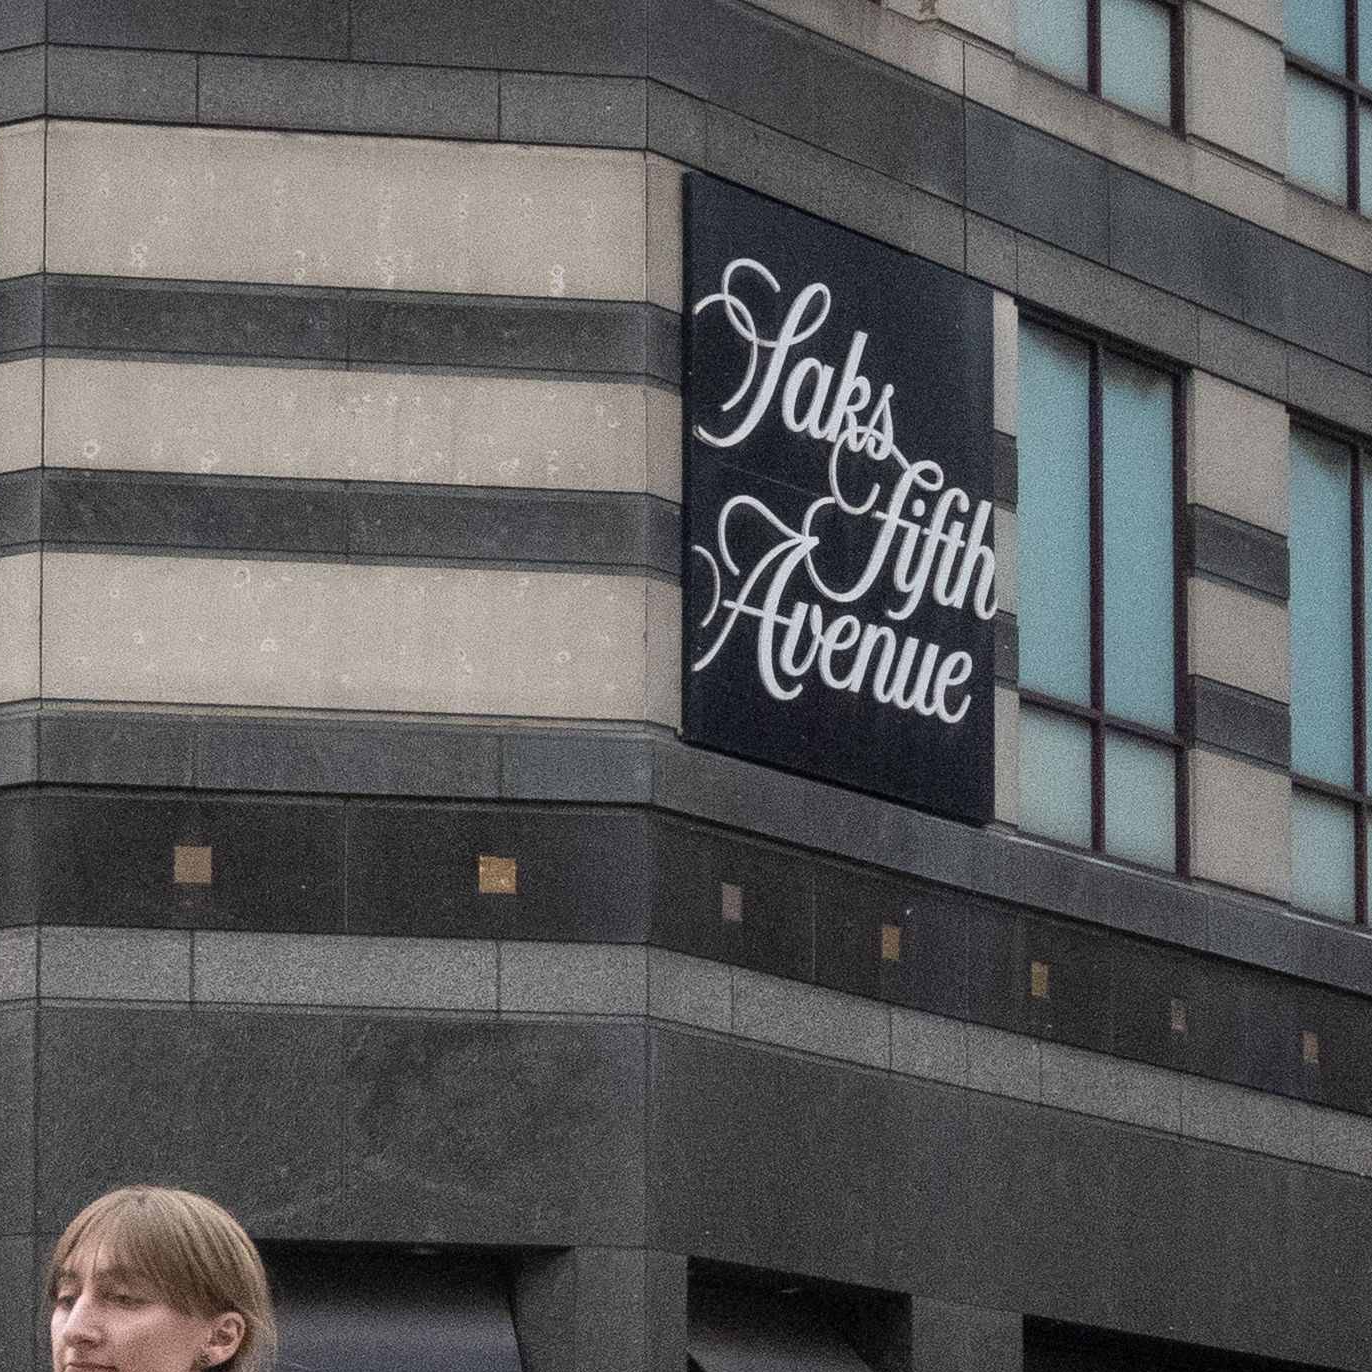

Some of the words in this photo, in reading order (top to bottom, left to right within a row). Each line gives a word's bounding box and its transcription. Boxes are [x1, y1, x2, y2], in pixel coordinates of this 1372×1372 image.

[694, 258, 896, 448] Saks
[693, 494, 974, 724] Avenue
[804, 424, 1000, 622] Fifth
